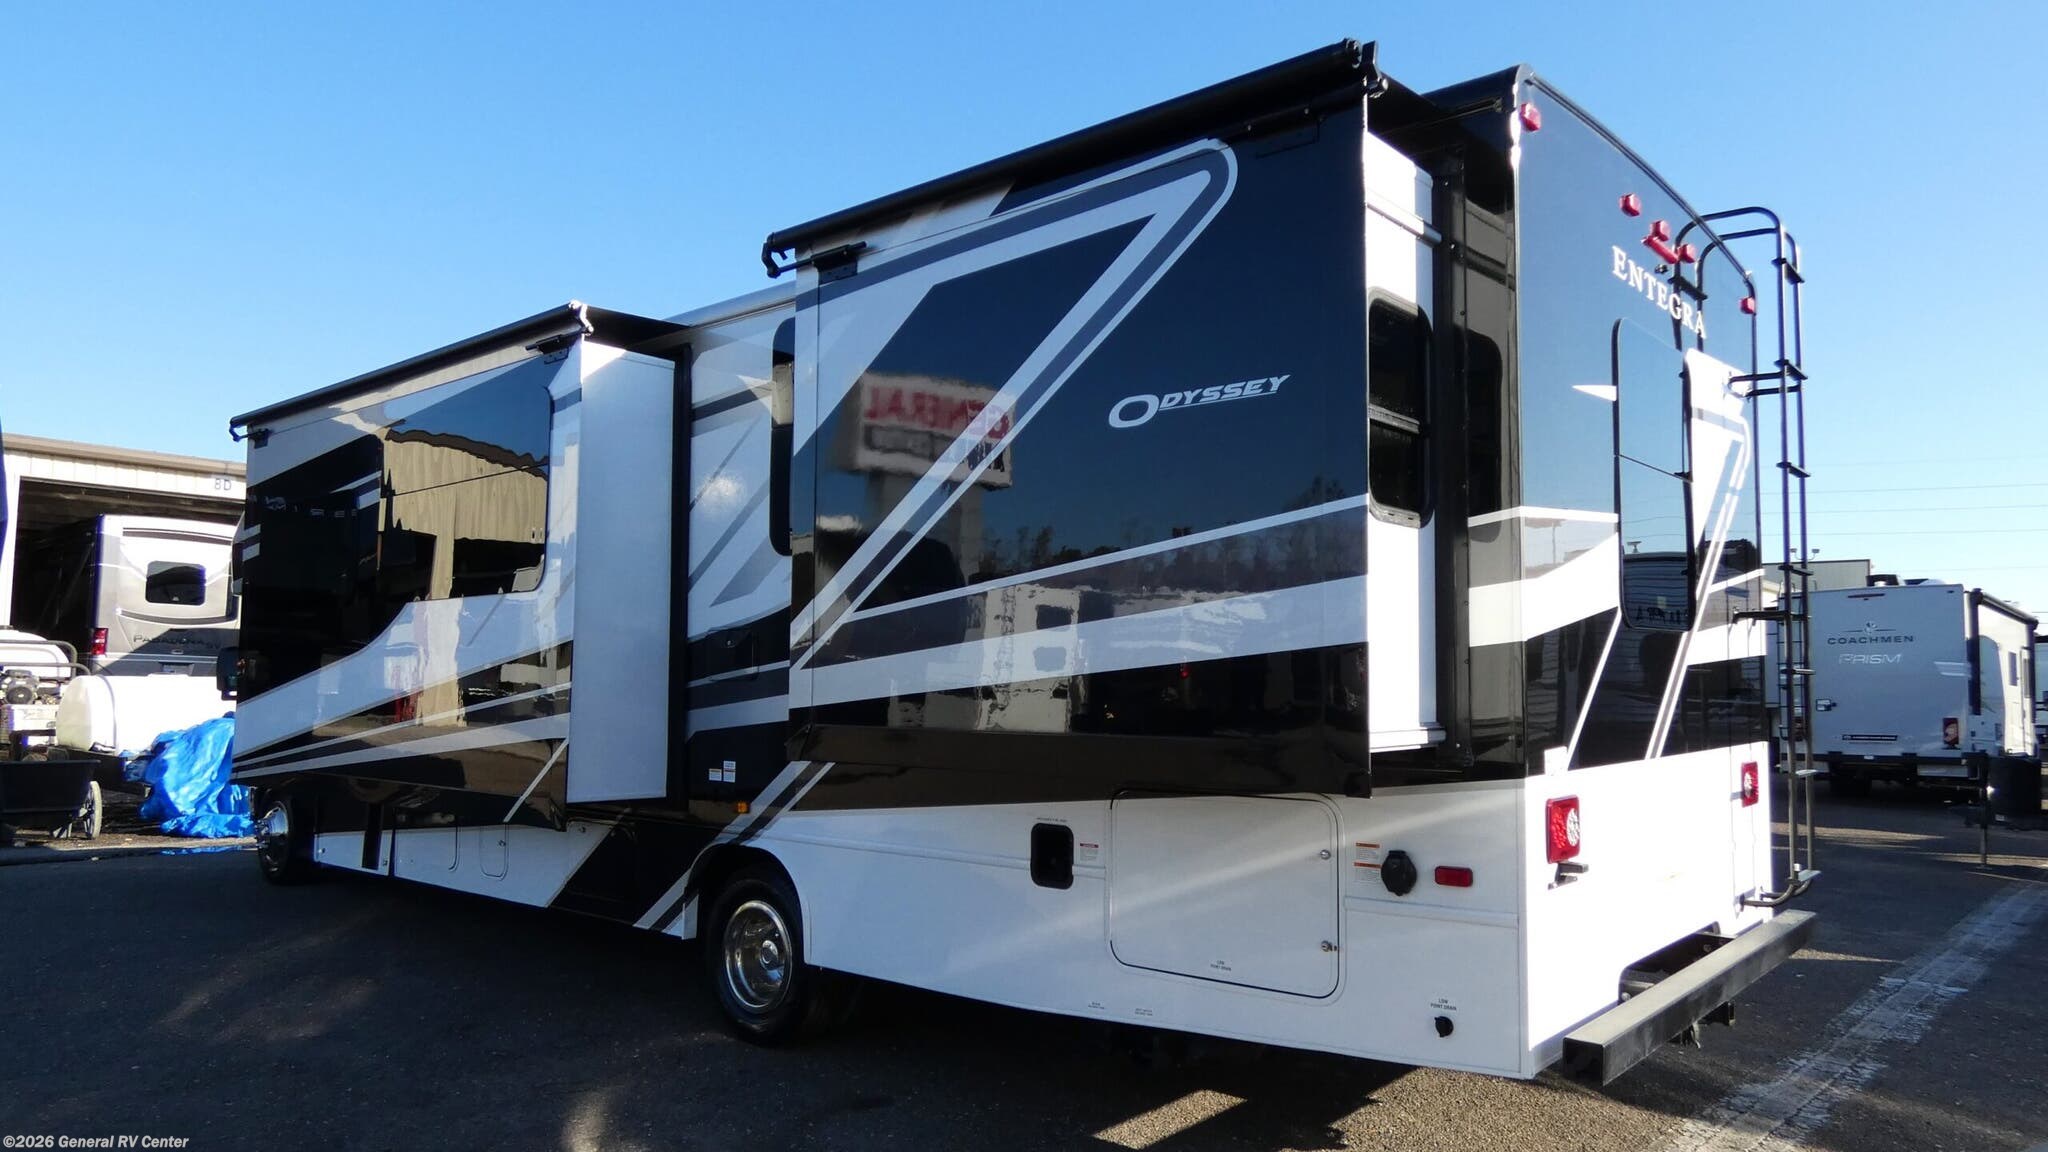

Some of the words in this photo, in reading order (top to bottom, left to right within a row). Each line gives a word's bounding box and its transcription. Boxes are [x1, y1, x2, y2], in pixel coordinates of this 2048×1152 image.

[1612, 244, 1707, 340] ENTEGRA
[1108, 374, 1291, 428] ODYSSEY
[1827, 635, 1914, 645] COACHMEN
[1839, 653, 1902, 664] PRISM
